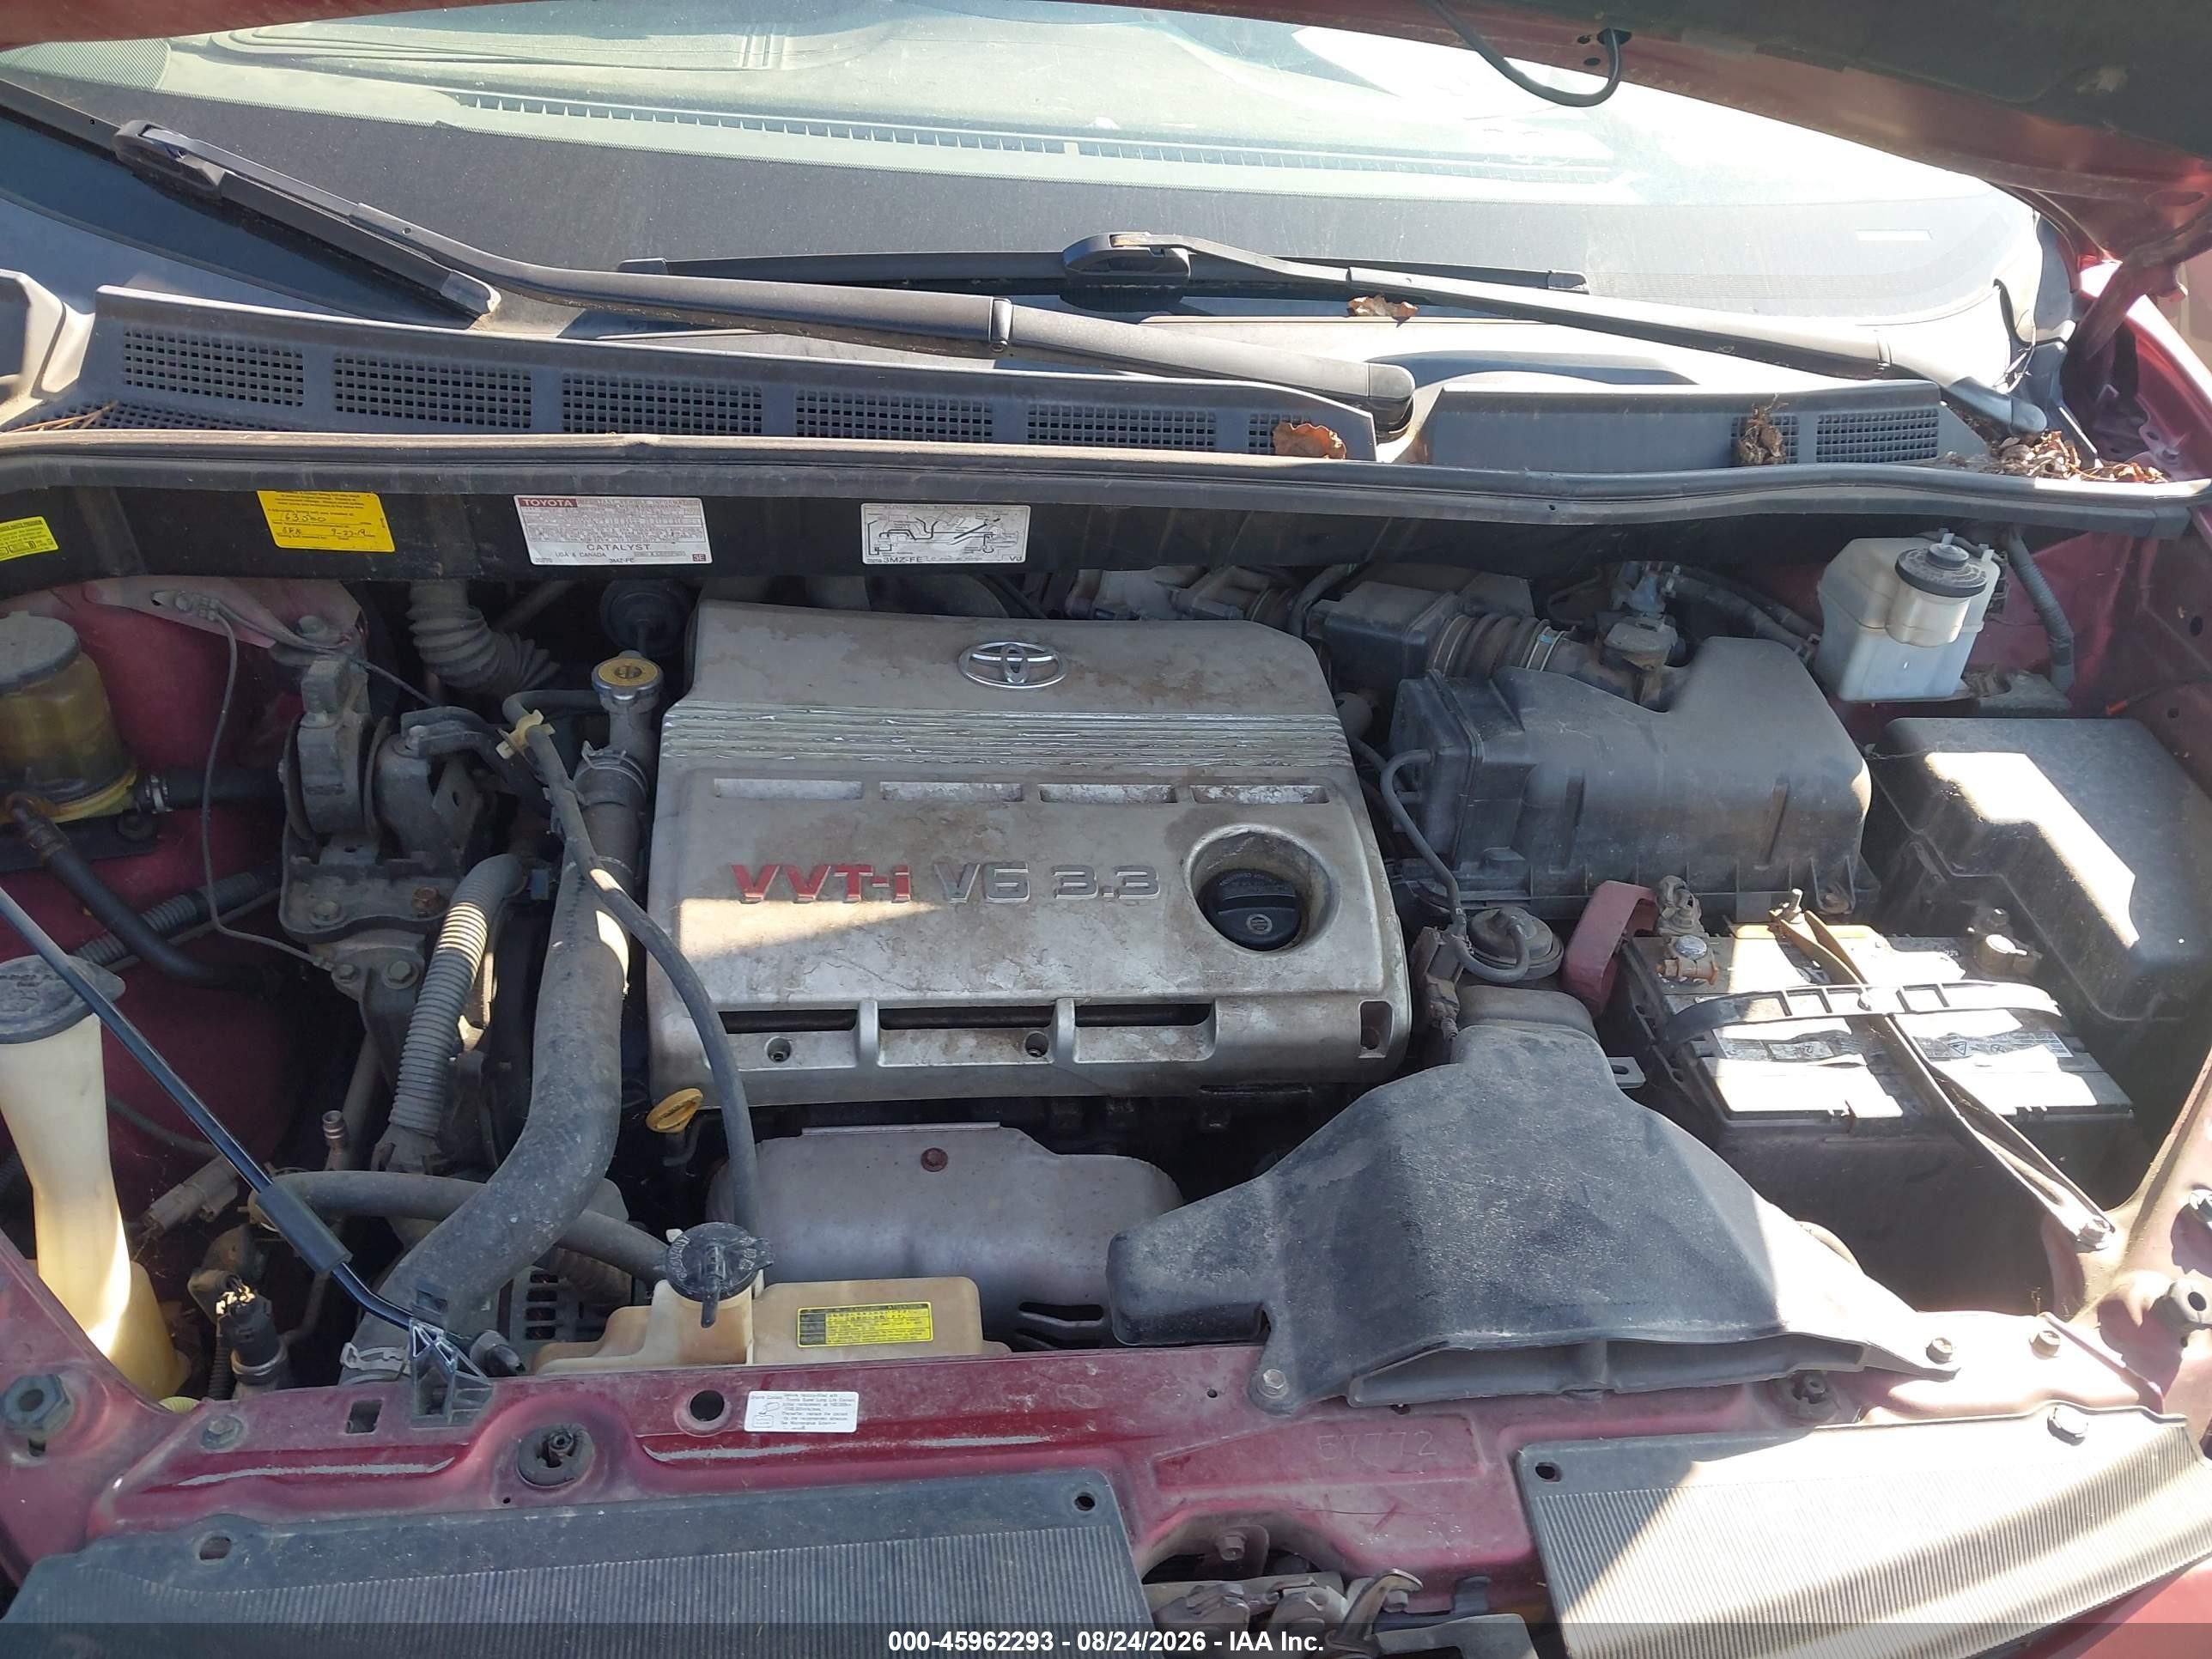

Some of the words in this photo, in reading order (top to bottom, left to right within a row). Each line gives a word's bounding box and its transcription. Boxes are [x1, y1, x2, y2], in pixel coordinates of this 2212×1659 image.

[523, 498, 573, 507] TOYOTA
[732, 863, 912, 904] VVT-i
[933, 861, 1032, 904] V6
[1051, 863, 1162, 901] 3.3
